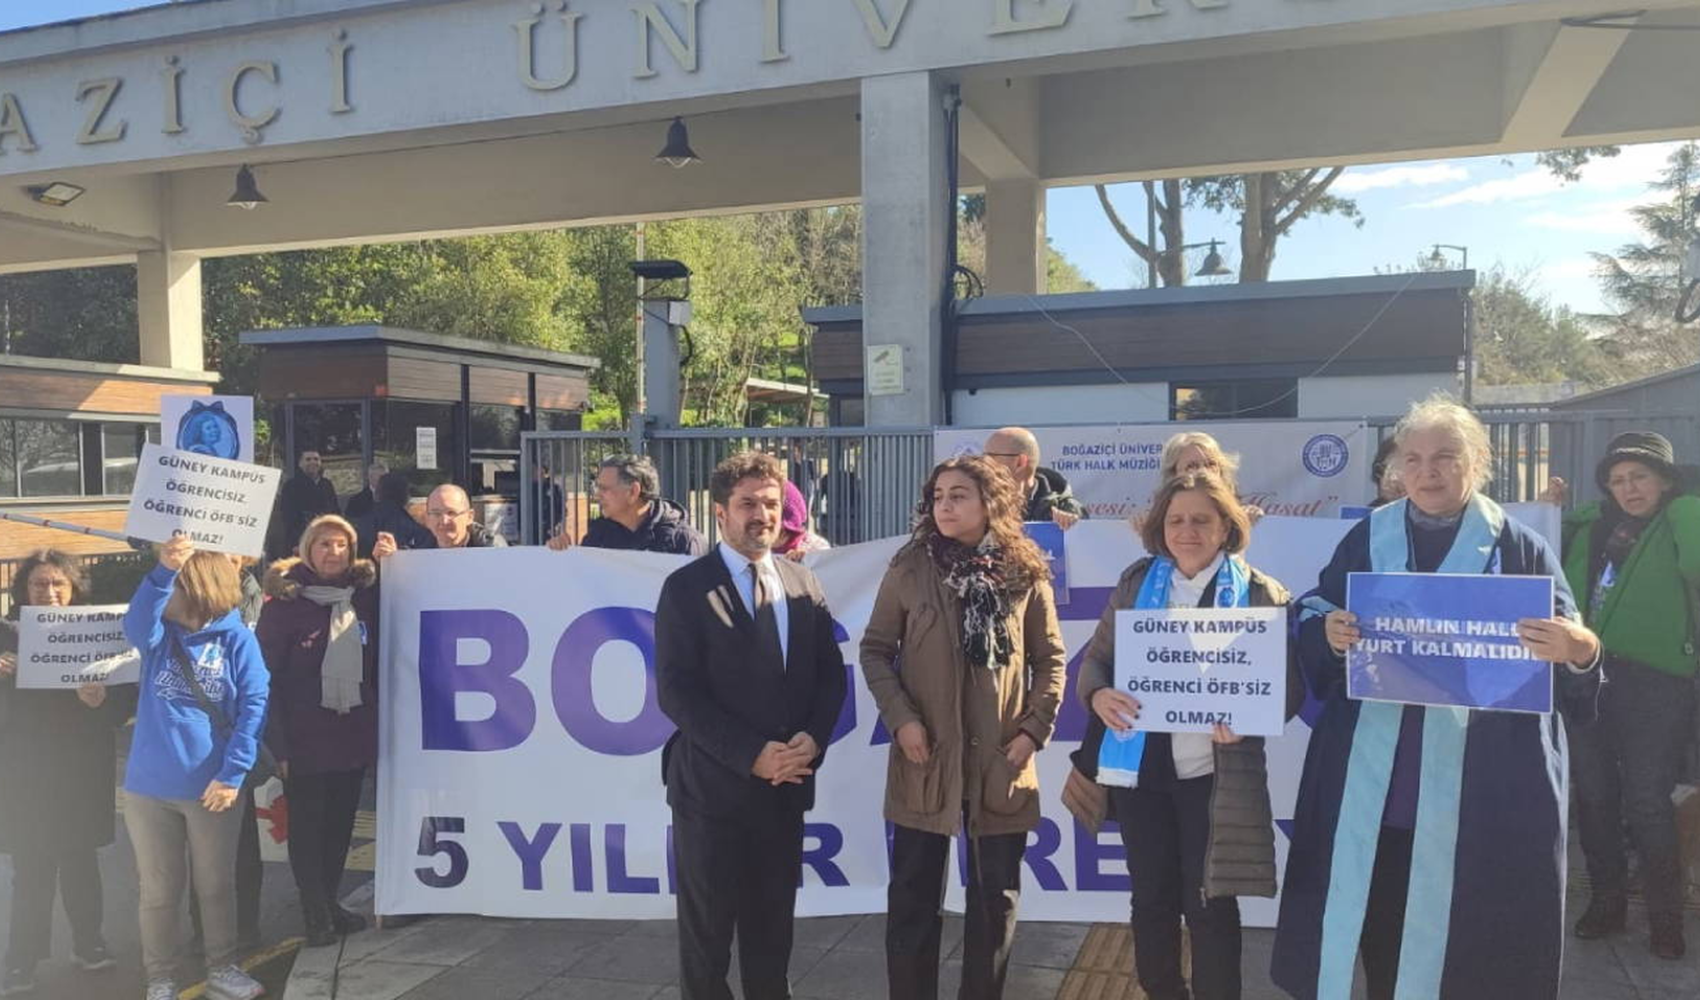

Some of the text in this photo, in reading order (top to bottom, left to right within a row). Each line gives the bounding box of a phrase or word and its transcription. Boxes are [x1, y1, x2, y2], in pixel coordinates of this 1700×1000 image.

[1062, 442, 1116, 456] BOĞAZİÇİ
[159, 455, 208, 474] GÜNEY
[1051, 458, 1081, 470] TÜRK
[1085, 460, 1116, 470] HALK
[36, 612, 83, 623] GÜNEY
[1133, 616, 1267, 634] GÜNEY KAMPÜS
[1354, 637, 1406, 654] YURT
[1146, 646, 1251, 665] ÖĞRENCİSİZ,
[1128, 676, 1271, 695] ÖĞRENCİ ÖFB'SİZ
[1165, 710, 1232, 725] OLMAZ!
[413, 816, 469, 889] 5
